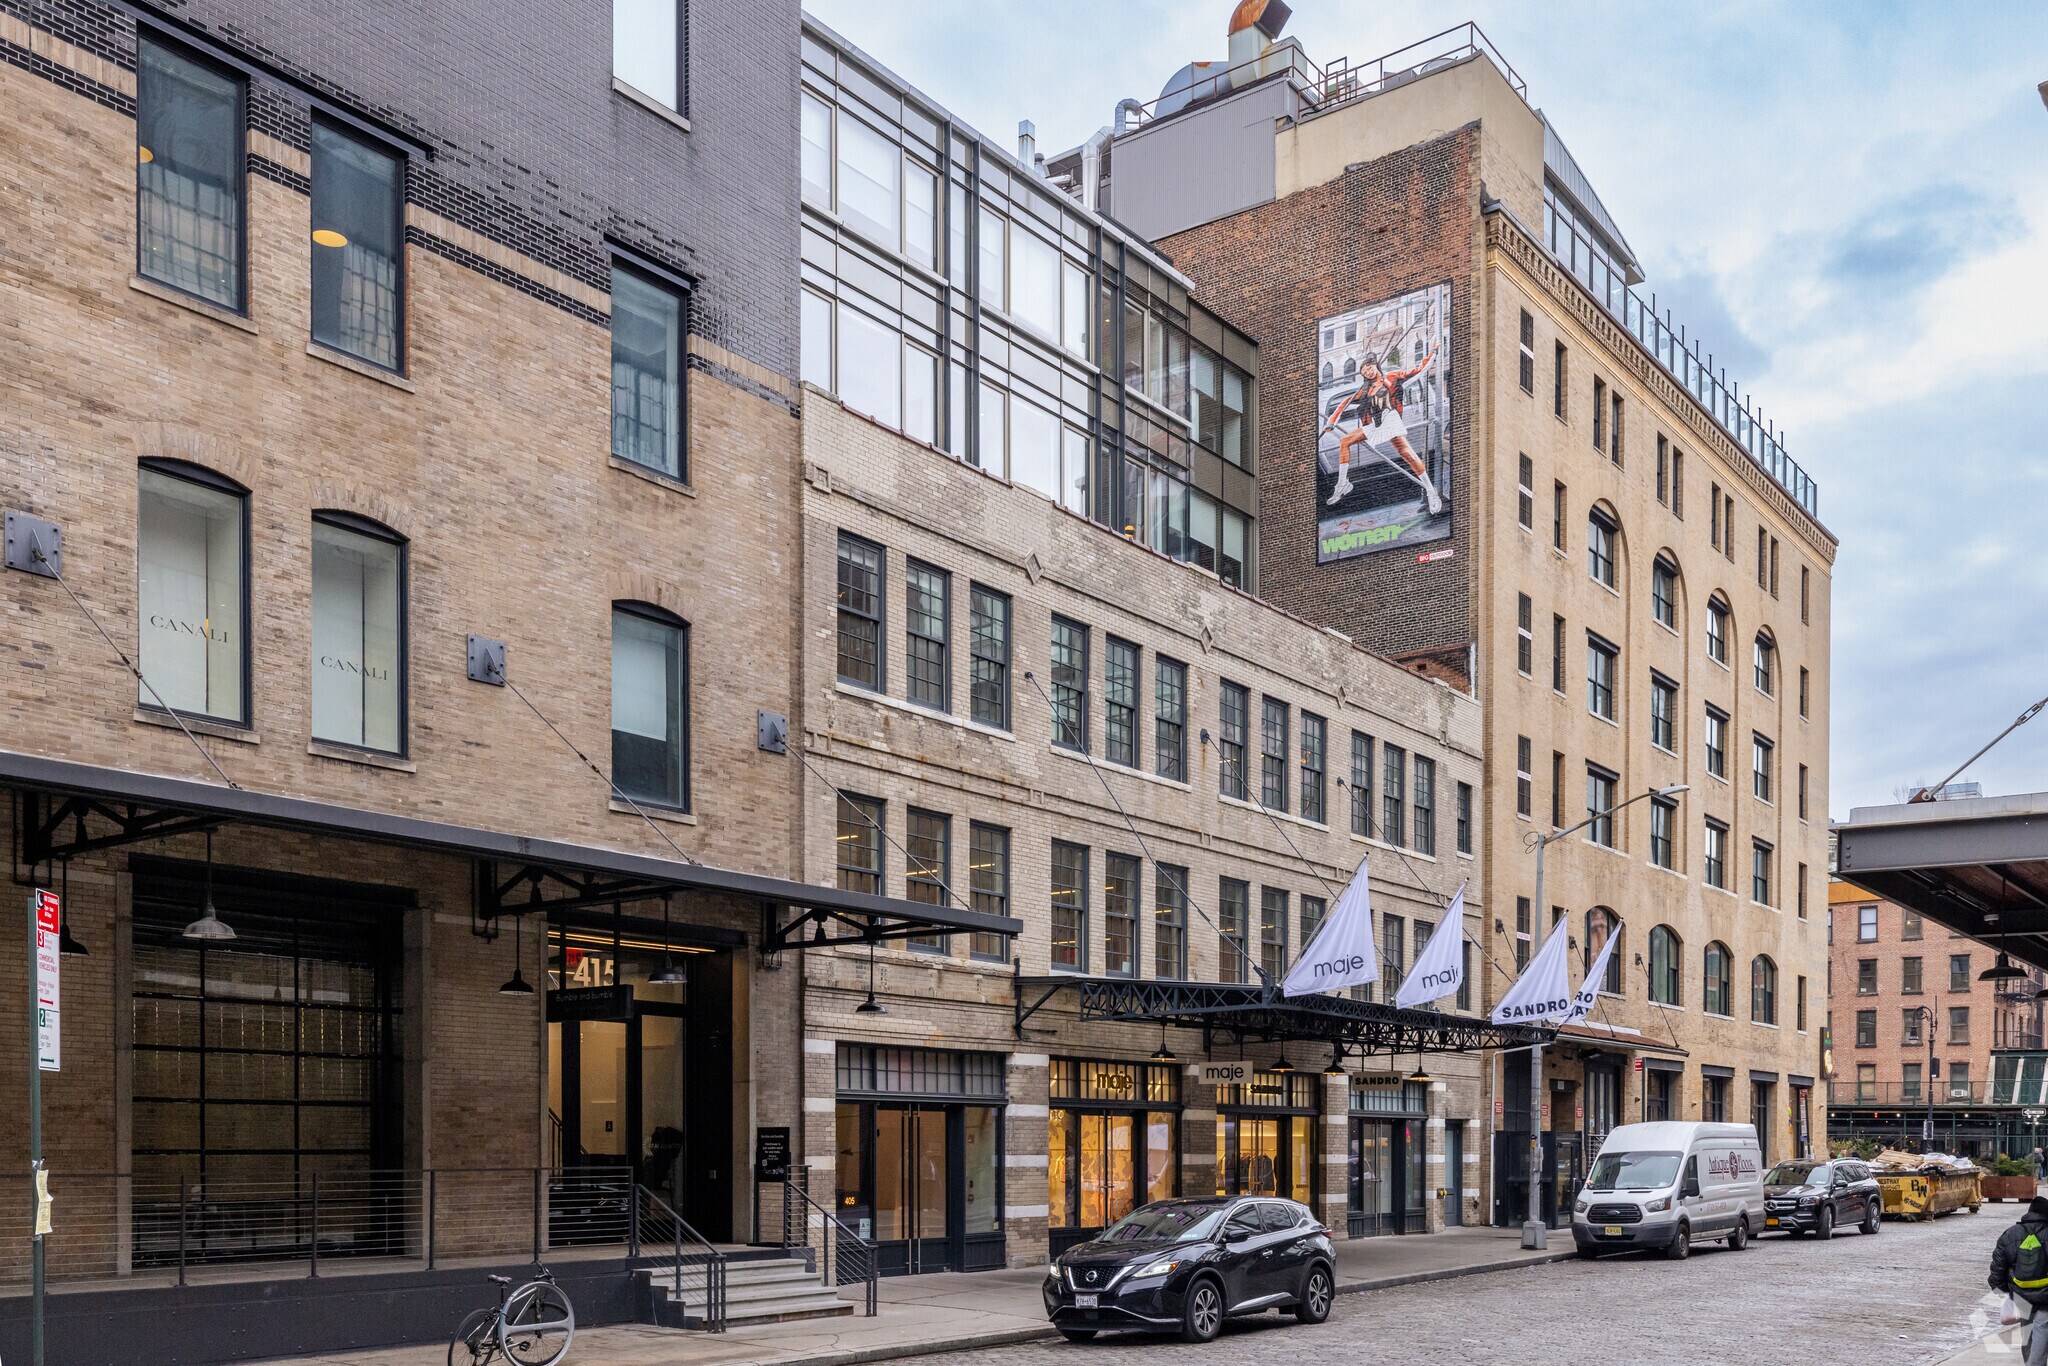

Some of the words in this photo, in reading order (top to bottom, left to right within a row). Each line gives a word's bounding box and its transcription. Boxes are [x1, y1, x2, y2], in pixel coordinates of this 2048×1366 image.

[1321, 525, 1401, 554] women
[1419, 554, 1429, 562] BIG
[150, 615, 228, 643] CANALI
[320, 655, 387, 681] CANALI
[39, 930, 44, 946] 3
[573, 956, 615, 987] 415
[1314, 954, 1364, 978] maje
[40, 1009, 45, 1026] 2
[1502, 998, 1568, 1018] SANDRO
[1096, 1070, 1133, 1093] maje
[1206, 1063, 1244, 1081] maje
[1355, 1076, 1400, 1085] SANDRO
[845, 1196, 856, 1205] 405
